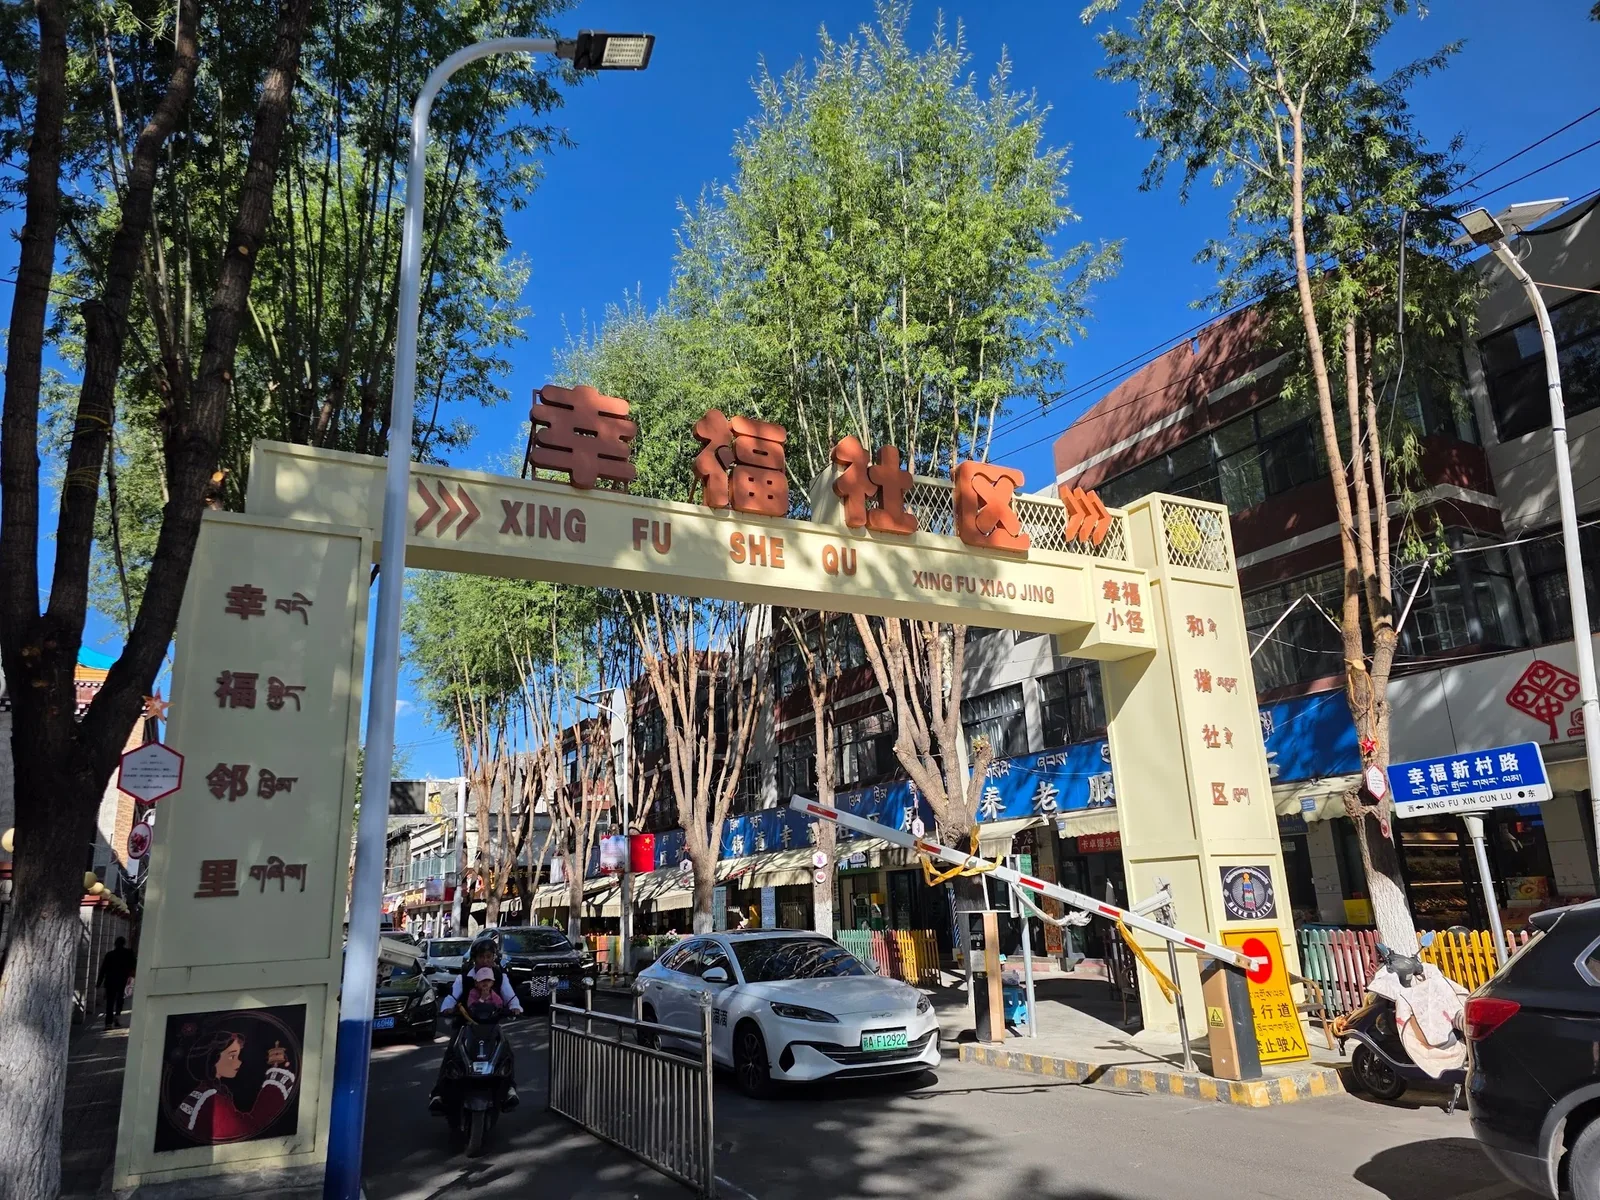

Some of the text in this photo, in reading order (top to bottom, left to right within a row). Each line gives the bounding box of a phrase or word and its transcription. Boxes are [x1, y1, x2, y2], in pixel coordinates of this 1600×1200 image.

[530, 385, 1030, 552] 幸福社区
[500, 500, 857, 576] XING FU SHE QU
[912, 569, 1055, 604] XING FU XIAO JING
[1102, 579, 1141, 607] 幸福
[1105, 607, 1145, 633] 小径
[1407, 752, 1520, 785] 幸福新村路
[1426, 792, 1512, 810] XING FU XIN CUN LU
[1527, 789, 1536, 798] 东
[1228, 901, 1272, 918] HAVE FAITH
